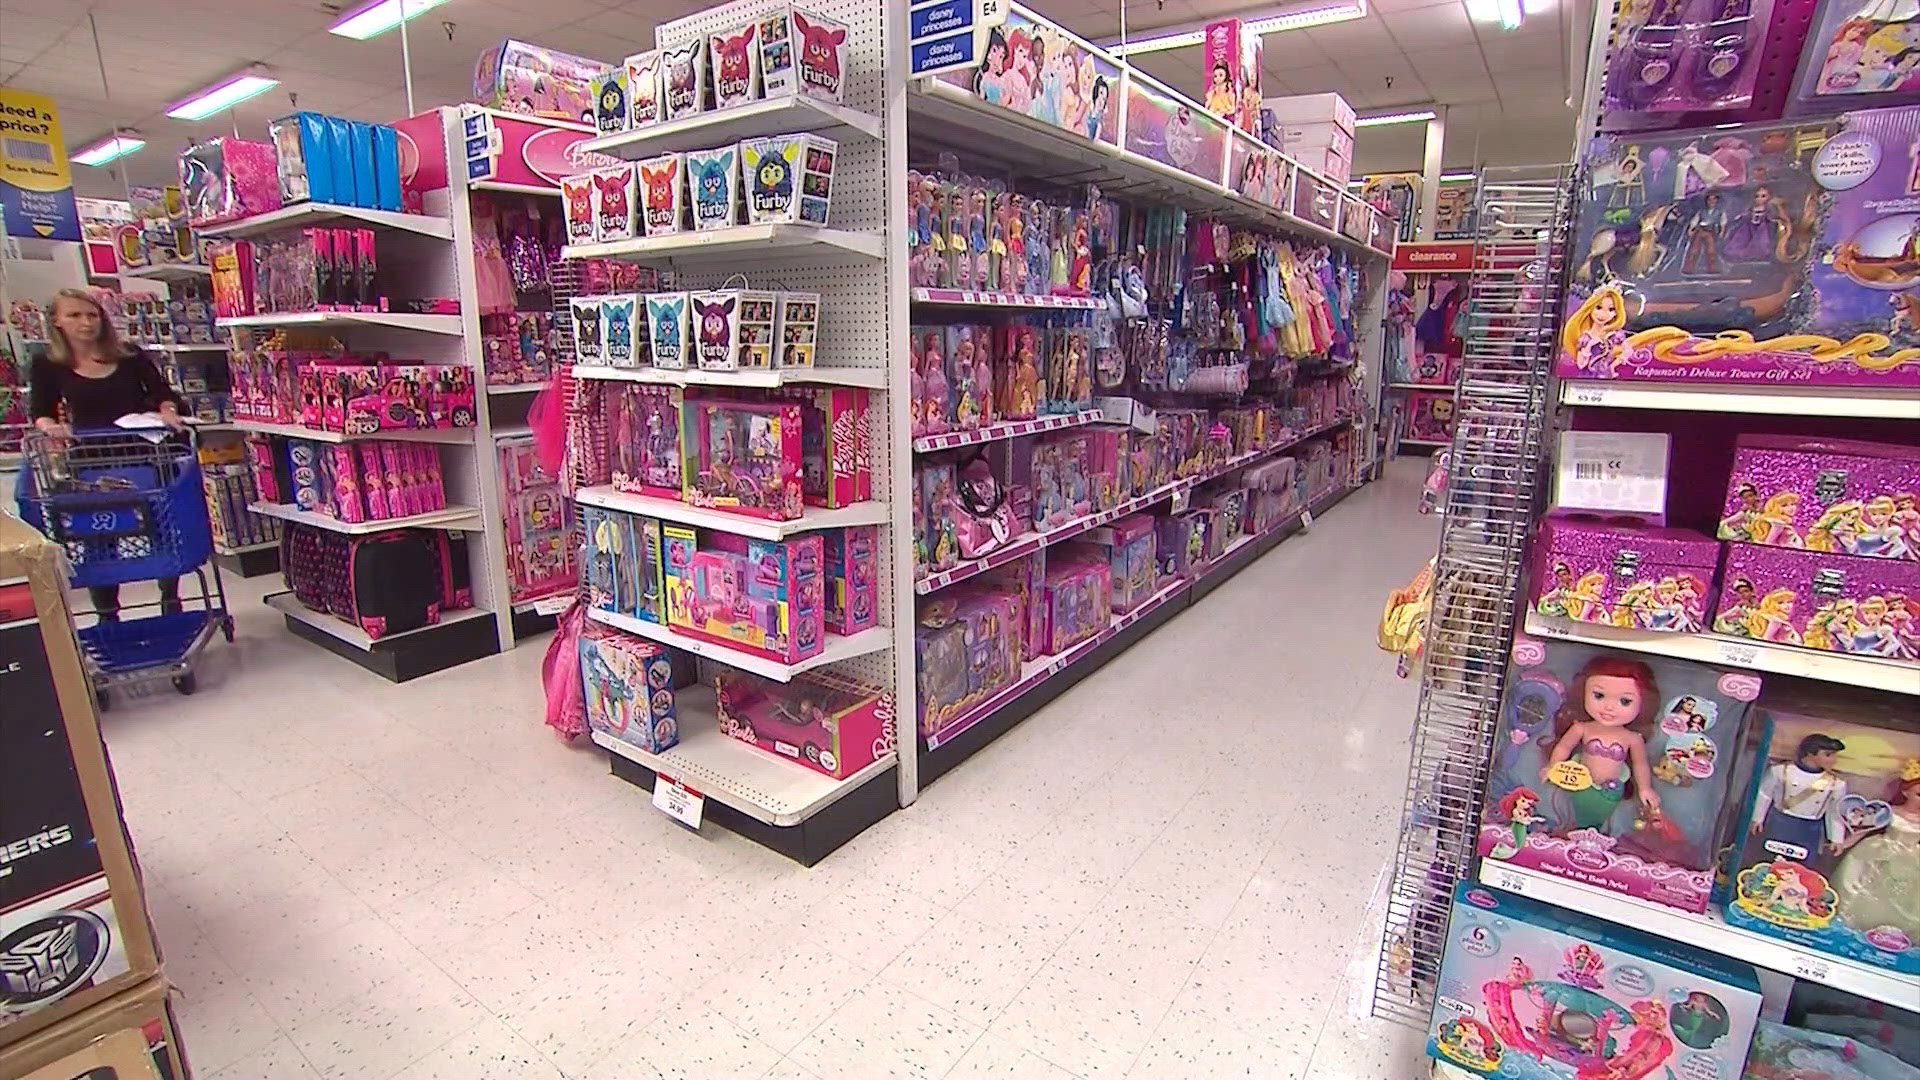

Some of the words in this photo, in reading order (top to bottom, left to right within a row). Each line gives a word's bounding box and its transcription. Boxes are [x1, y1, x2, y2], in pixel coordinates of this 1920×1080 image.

[928, 8, 954, 21] disney
[983, 1, 997, 16] E4
[921, 17, 962, 35] princesses
[929, 42, 955, 56] disney
[921, 52, 963, 70] princesses
[802, 64, 839, 91] Furby
[719, 76, 748, 98] Furby
[42, 112, 52, 121] a
[600, 115, 625, 132] Furby
[0, 120, 49, 136] price?
[754, 192, 791, 211] Furby
[648, 208, 674, 226] Furby
[699, 202, 728, 220] Furby
[570, 221, 594, 237] Furby
[601, 213, 627, 231] Furby
[1409, 251, 1457, 261] clearance
[608, 341, 630, 358] Furby
[655, 341, 679, 360] Furby
[701, 340, 729, 360] Furby
[1634, 366, 1687, 377] Rapunzel's
[1689, 367, 1727, 378] Deluxe
[1729, 369, 1764, 379] Tower
[1765, 369, 1789, 381] Gift
[1790, 369, 1812, 380] Set
[728, 719, 759, 745] Barbie
[872, 691, 893, 761] Barbie
[1565, 774, 1577, 782] 10
[1473, 927, 1485, 940] 6
